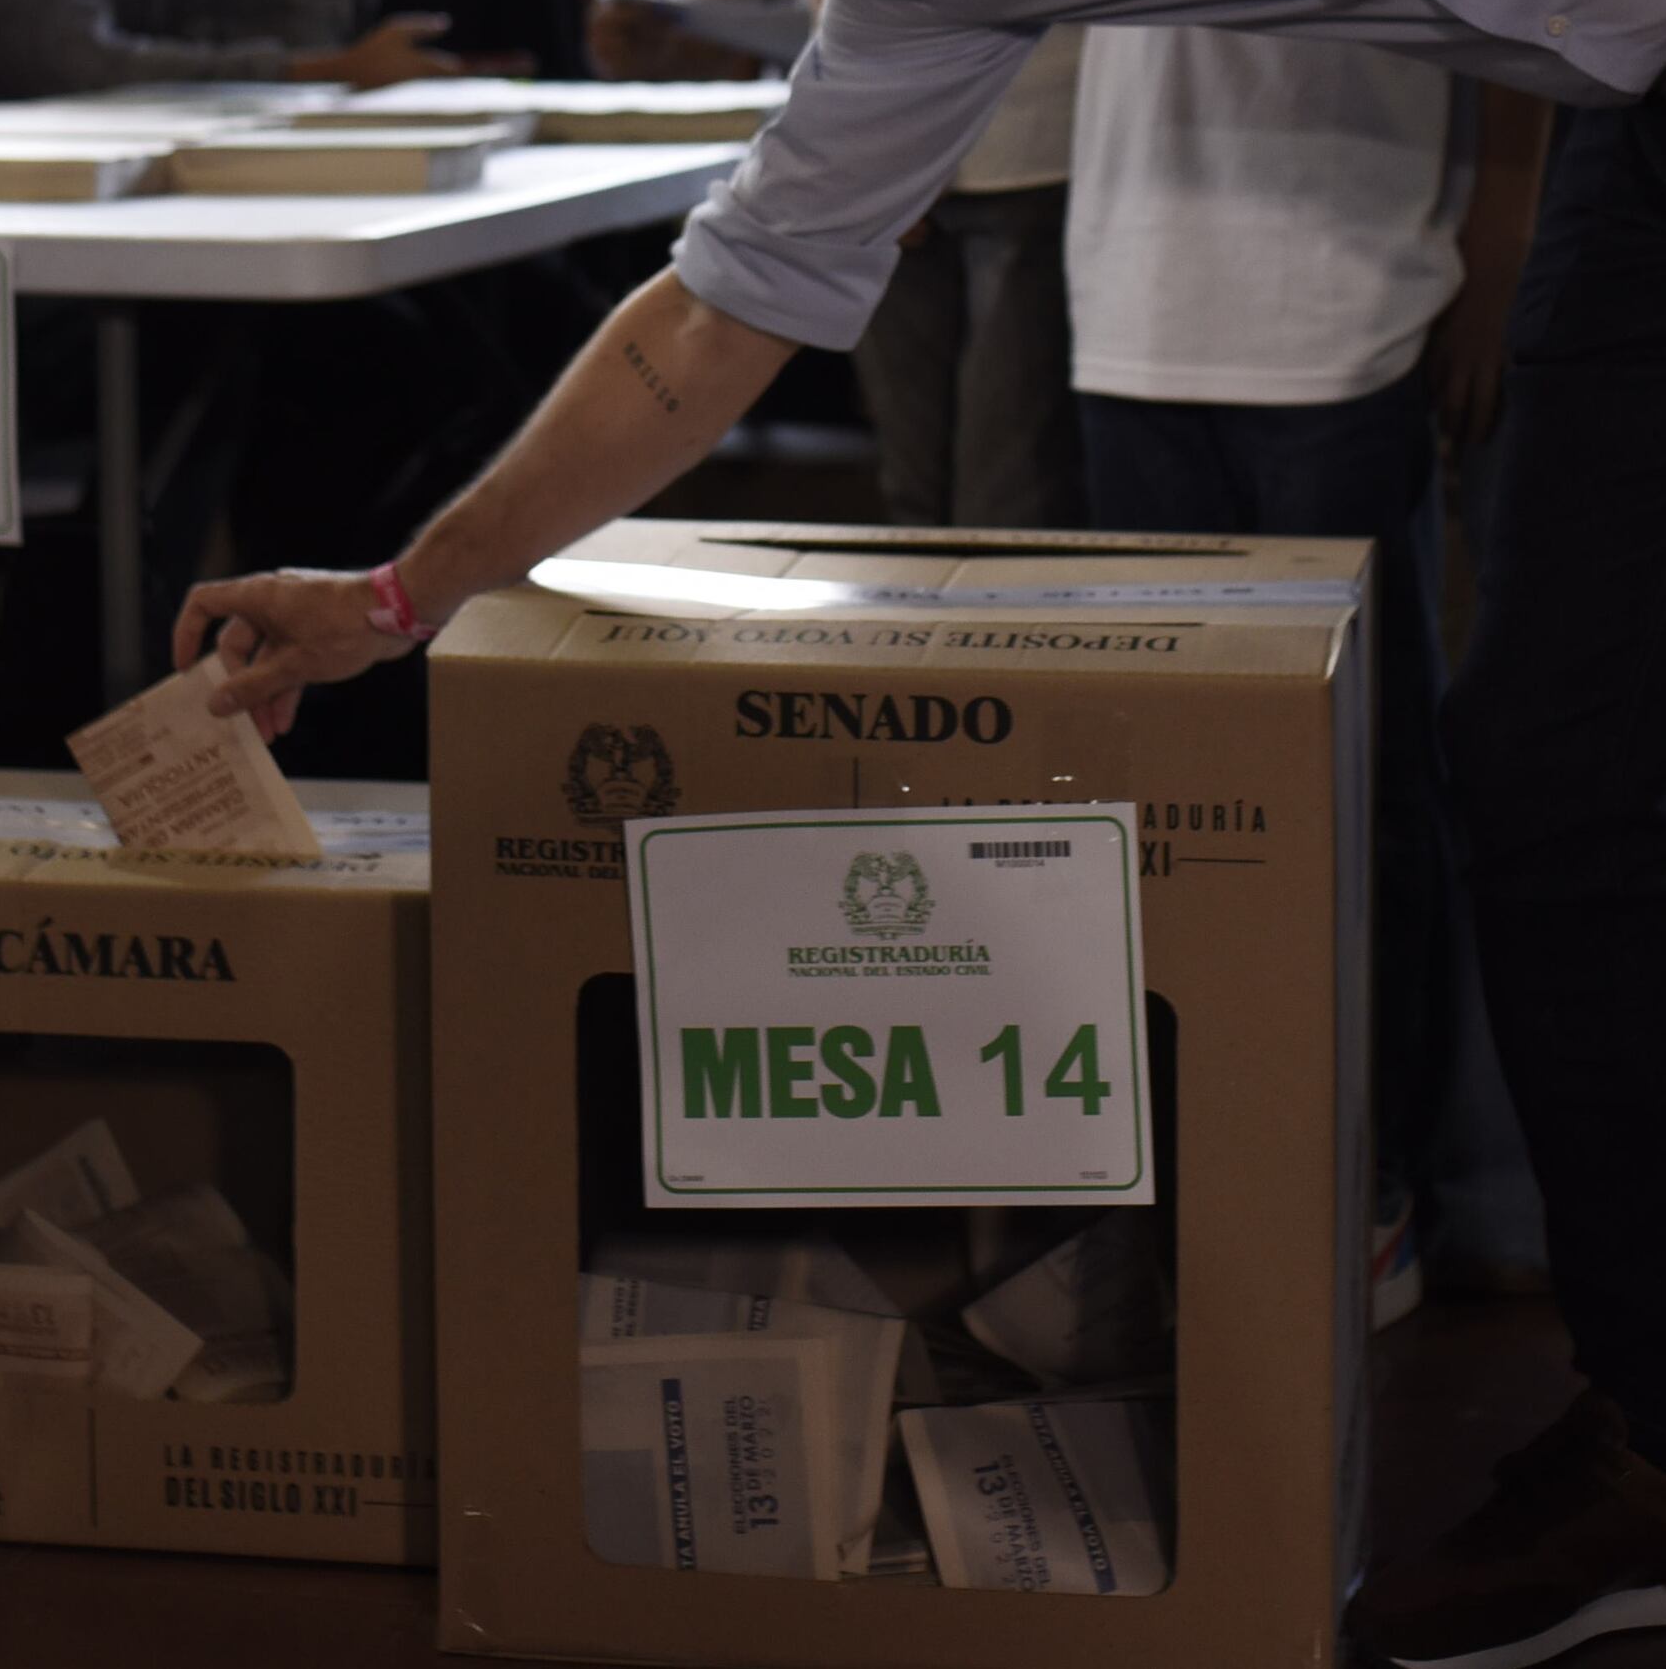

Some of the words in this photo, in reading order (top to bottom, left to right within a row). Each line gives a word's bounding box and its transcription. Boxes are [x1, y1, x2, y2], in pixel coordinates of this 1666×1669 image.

[944, 630, 1180, 652] DEPOSITE
[735, 689, 1013, 744] SENADO
[788, 939, 990, 964] REGISTRADURÍA
[680, 1025, 942, 1119] MESA
[980, 1024, 1111, 1117] 14
[973, 1460, 1007, 1496] 13
[748, 1495, 779, 1528] 13
